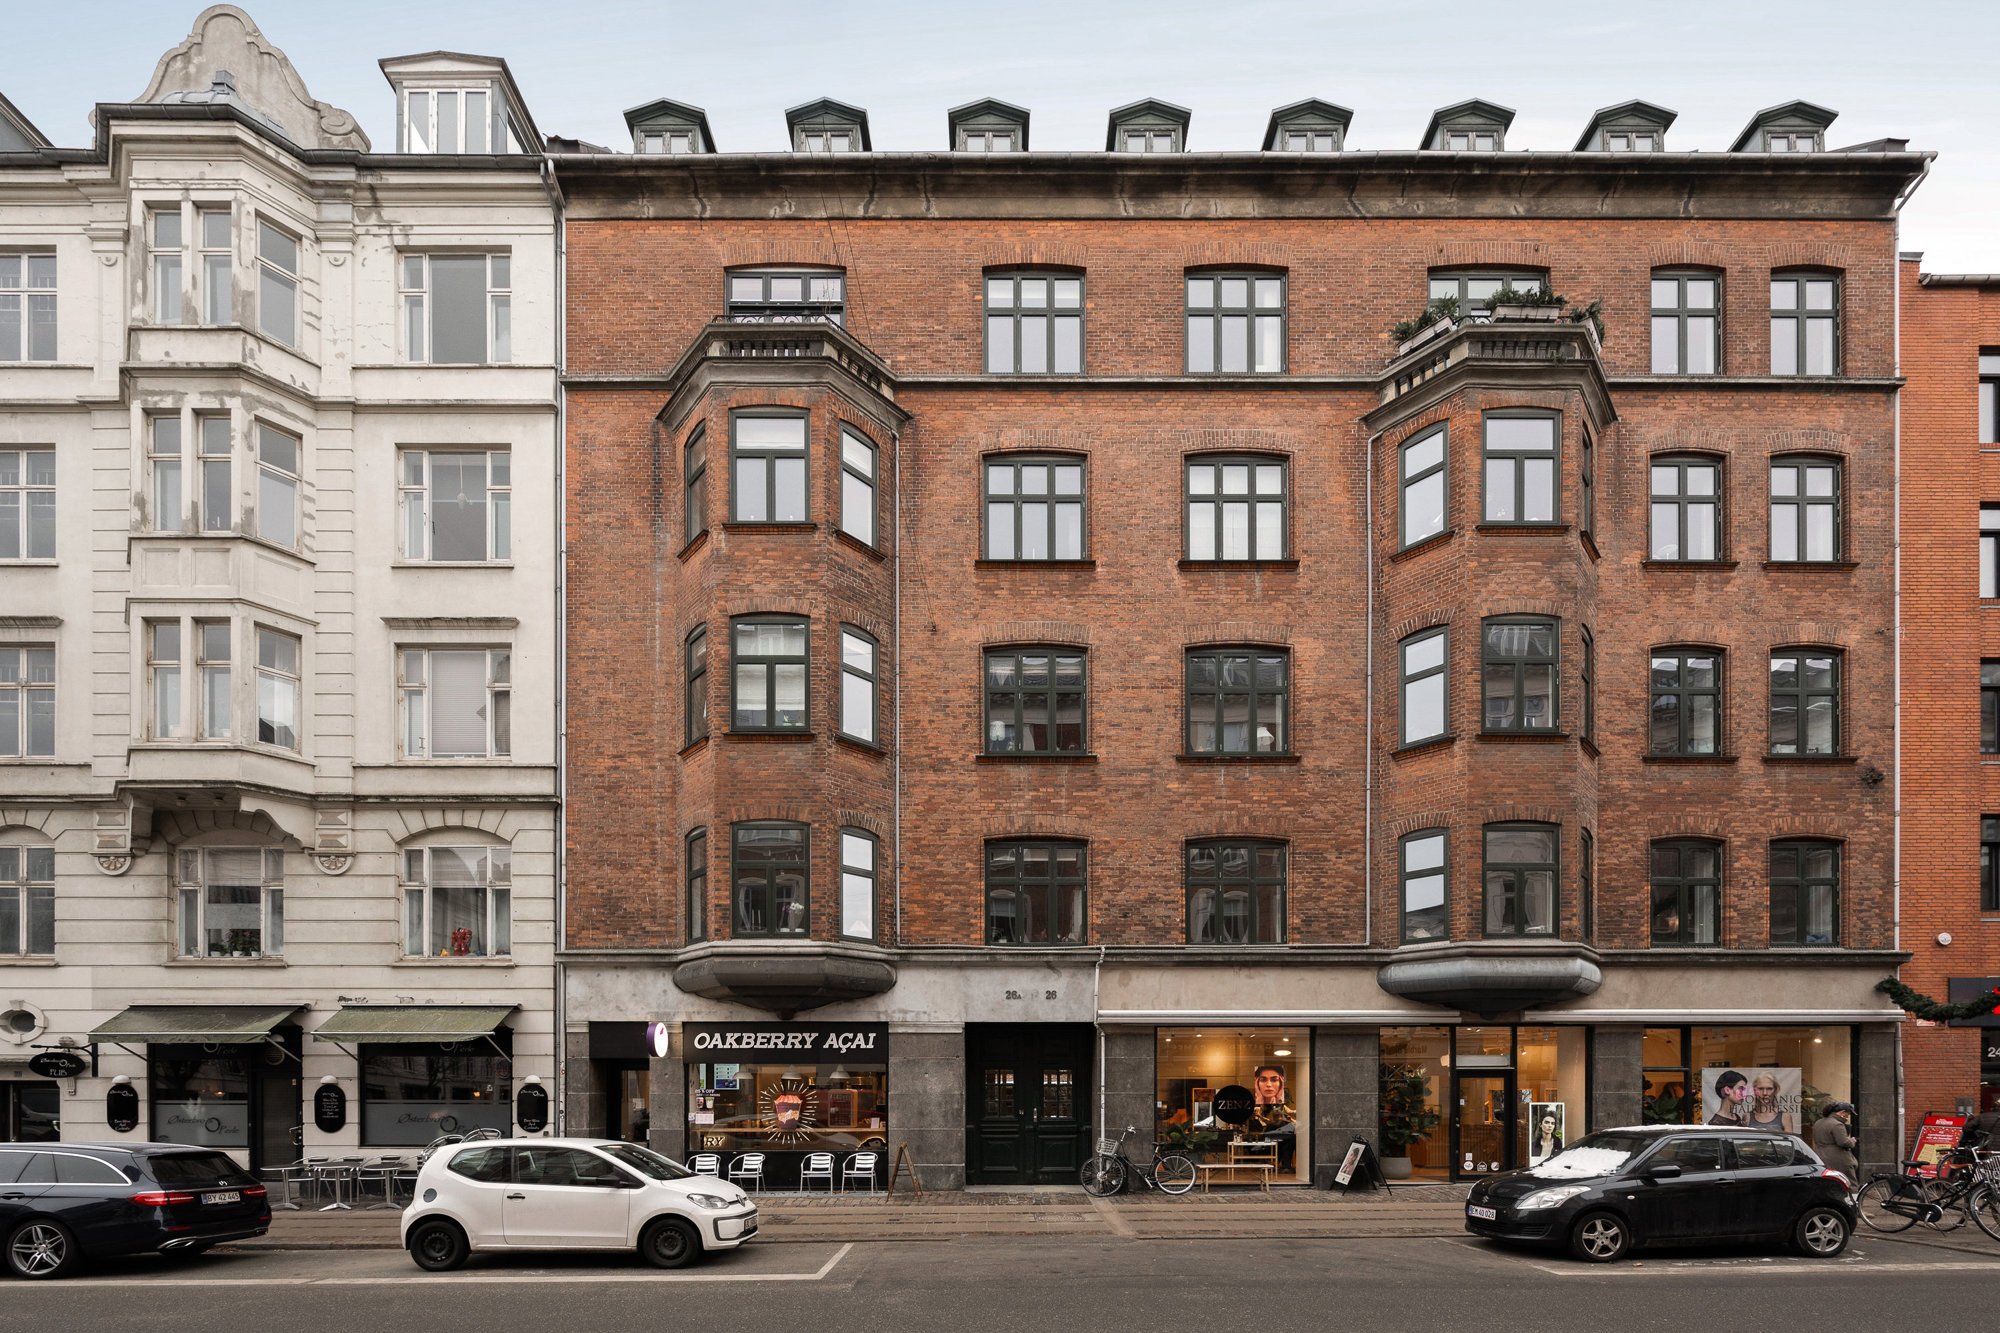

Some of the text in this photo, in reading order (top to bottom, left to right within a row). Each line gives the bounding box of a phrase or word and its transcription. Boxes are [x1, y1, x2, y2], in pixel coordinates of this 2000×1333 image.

[1005, 990, 1022, 1000] 26A
[1045, 990, 1057, 1000] 26
[694, 1032, 876, 1053] OAKBERRY AÇAI
[49, 1068, 68, 1077] PUB
[1218, 1099, 1252, 1110] ZENZ
[1745, 1094, 1803, 1105] ORGANIC
[1729, 1104, 1819, 1114] HAIRDRESSING
[228, 1192, 240, 1200] 445
[1485, 1210, 1495, 1219] 028
